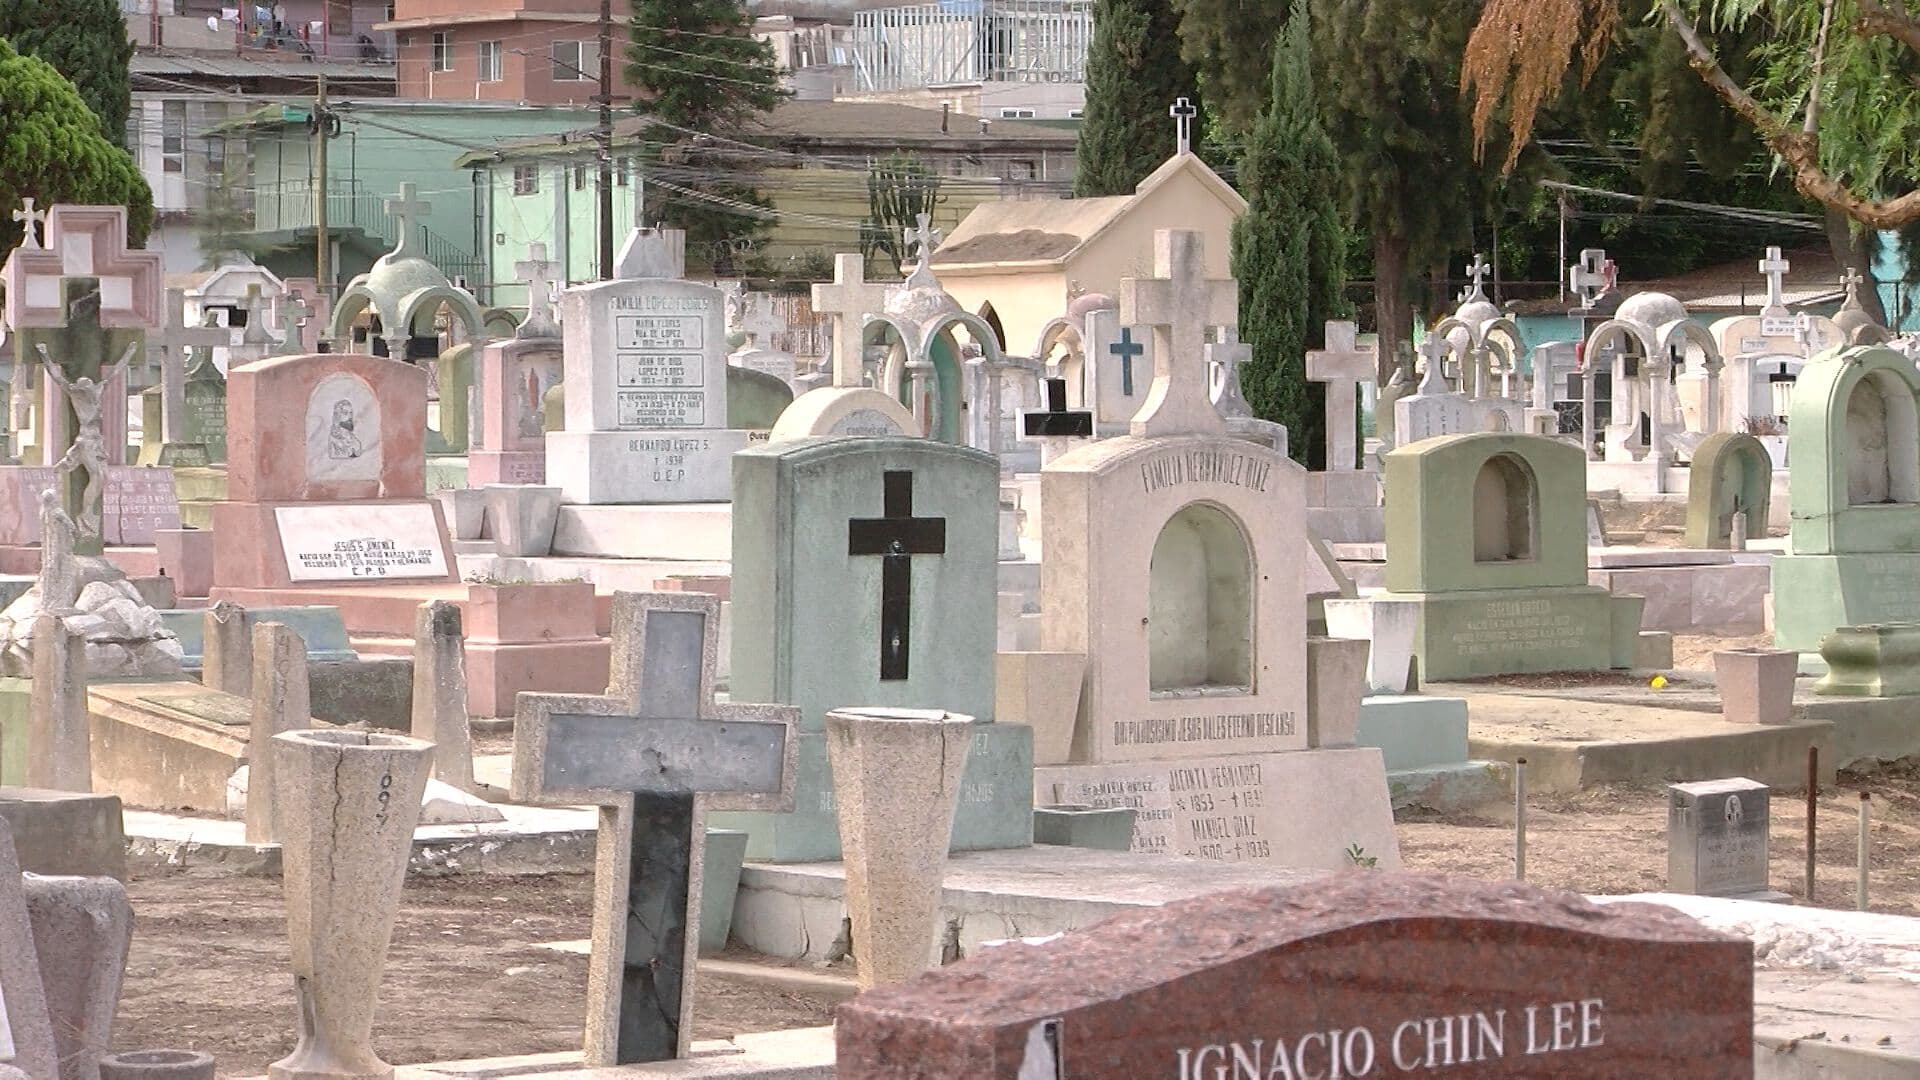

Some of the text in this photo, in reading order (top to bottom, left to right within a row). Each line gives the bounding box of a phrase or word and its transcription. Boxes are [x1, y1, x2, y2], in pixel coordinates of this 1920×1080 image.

[629, 439, 671, 452] BERNARDO
[673, 439, 700, 452] LOPEZ
[1141, 455, 1183, 494] FAMILIA
[1178, 717, 1201, 742] JESUS
[1168, 767, 1209, 792] JACINTA
[1190, 792, 1215, 812] 1853
[1191, 815, 1257, 841] MANUEL DIAZ
[1177, 998, 1605, 1080] IGNACIO CHIN LEE
